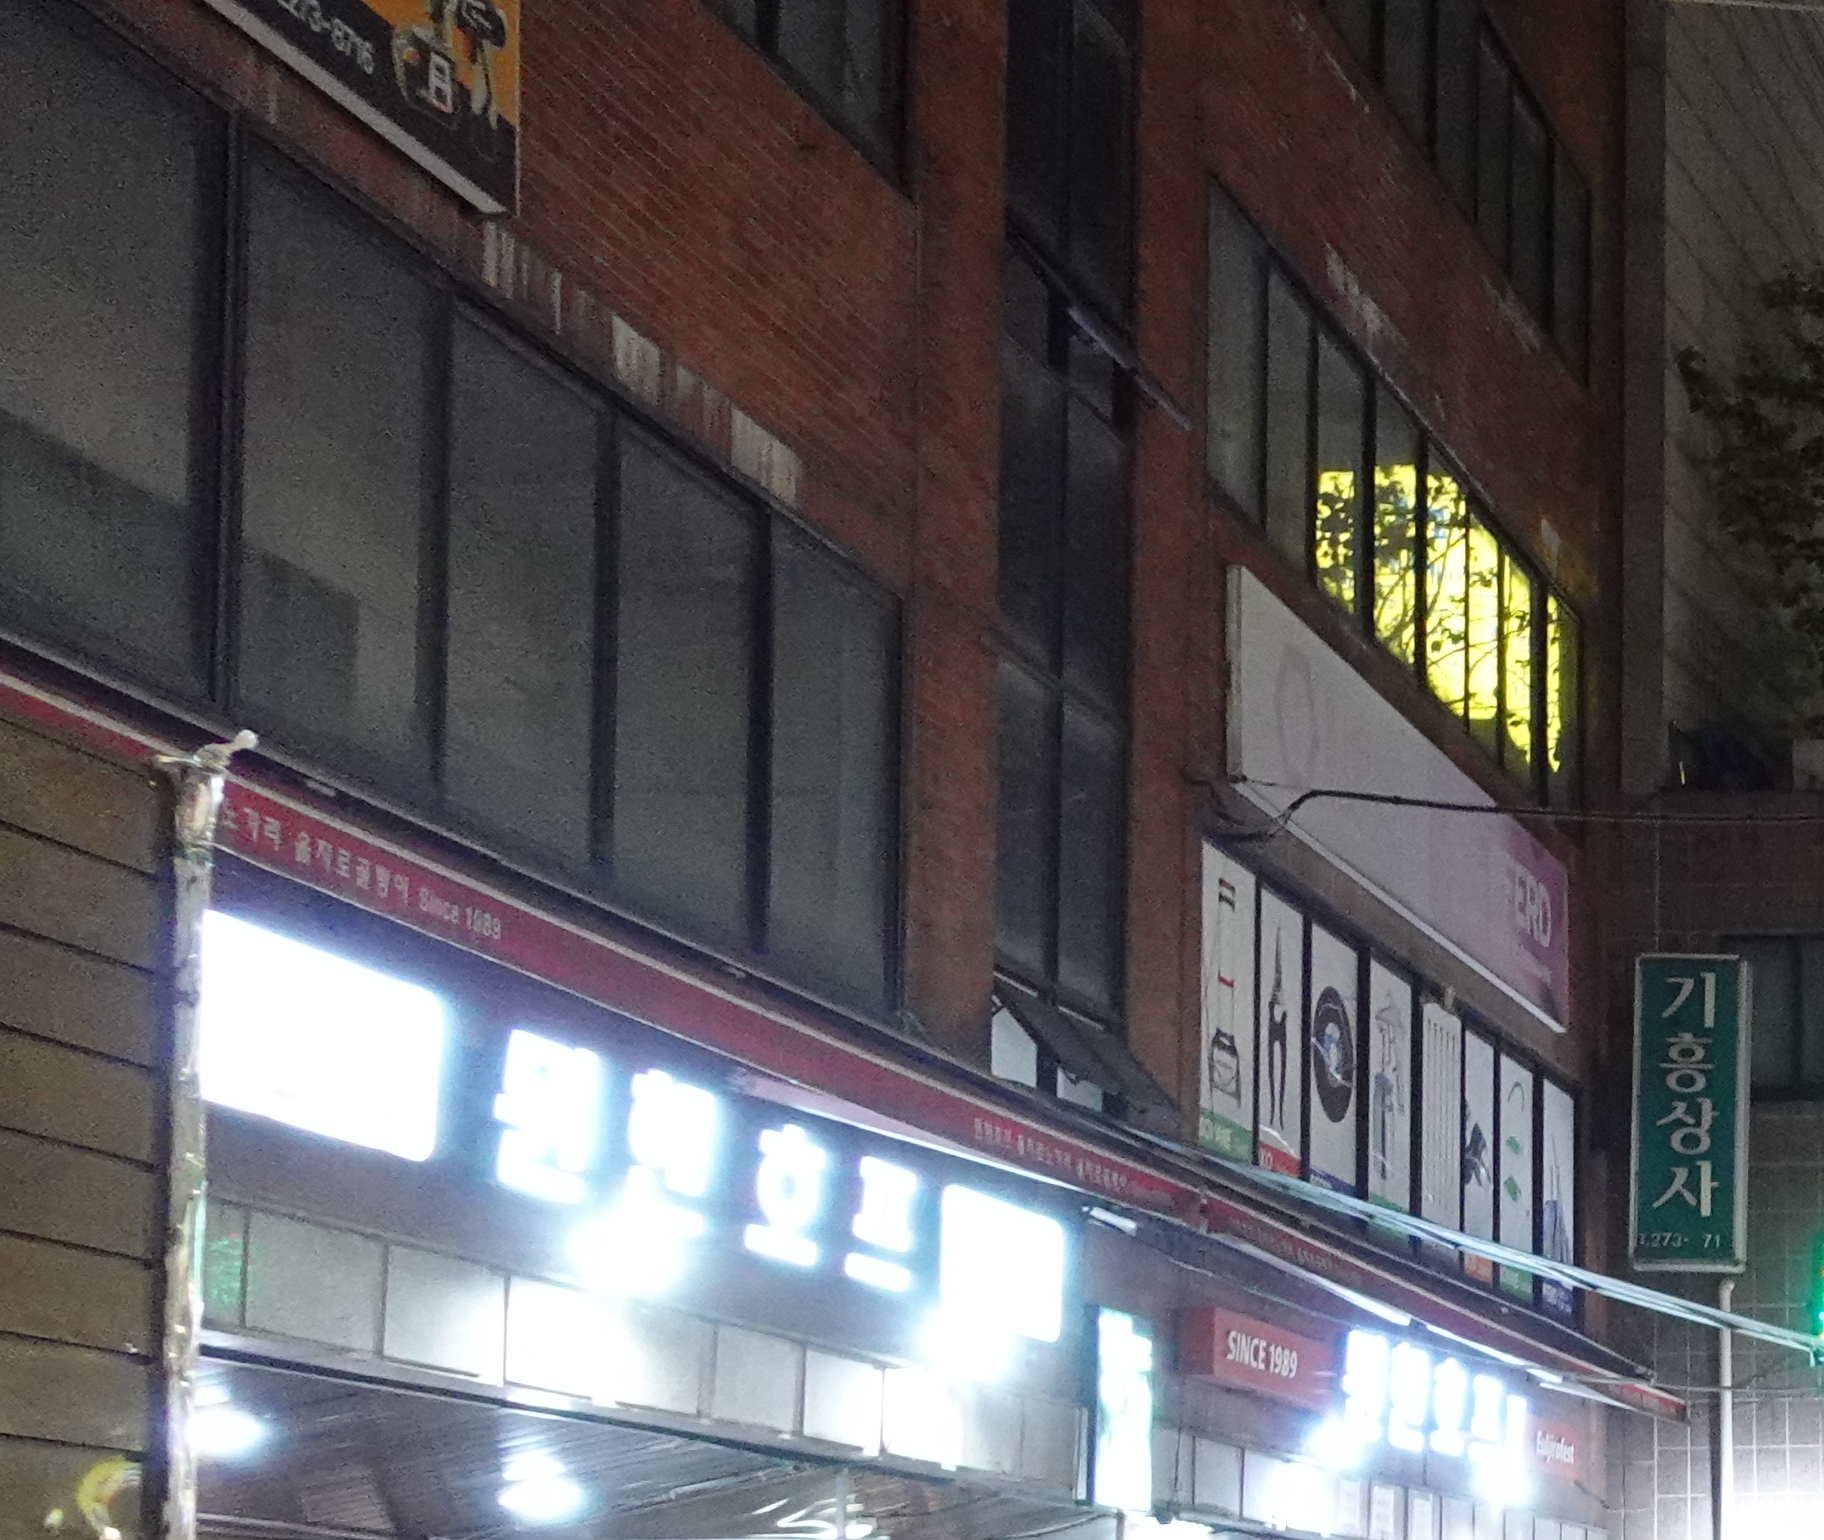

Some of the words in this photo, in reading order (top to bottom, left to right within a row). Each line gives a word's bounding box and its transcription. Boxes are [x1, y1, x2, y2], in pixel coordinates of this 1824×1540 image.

[1651, 969, 1721, 1218] 기흥상사
[1226, 1329, 1267, 1370] SINCE
[1268, 1343, 1298, 1379] 1989
